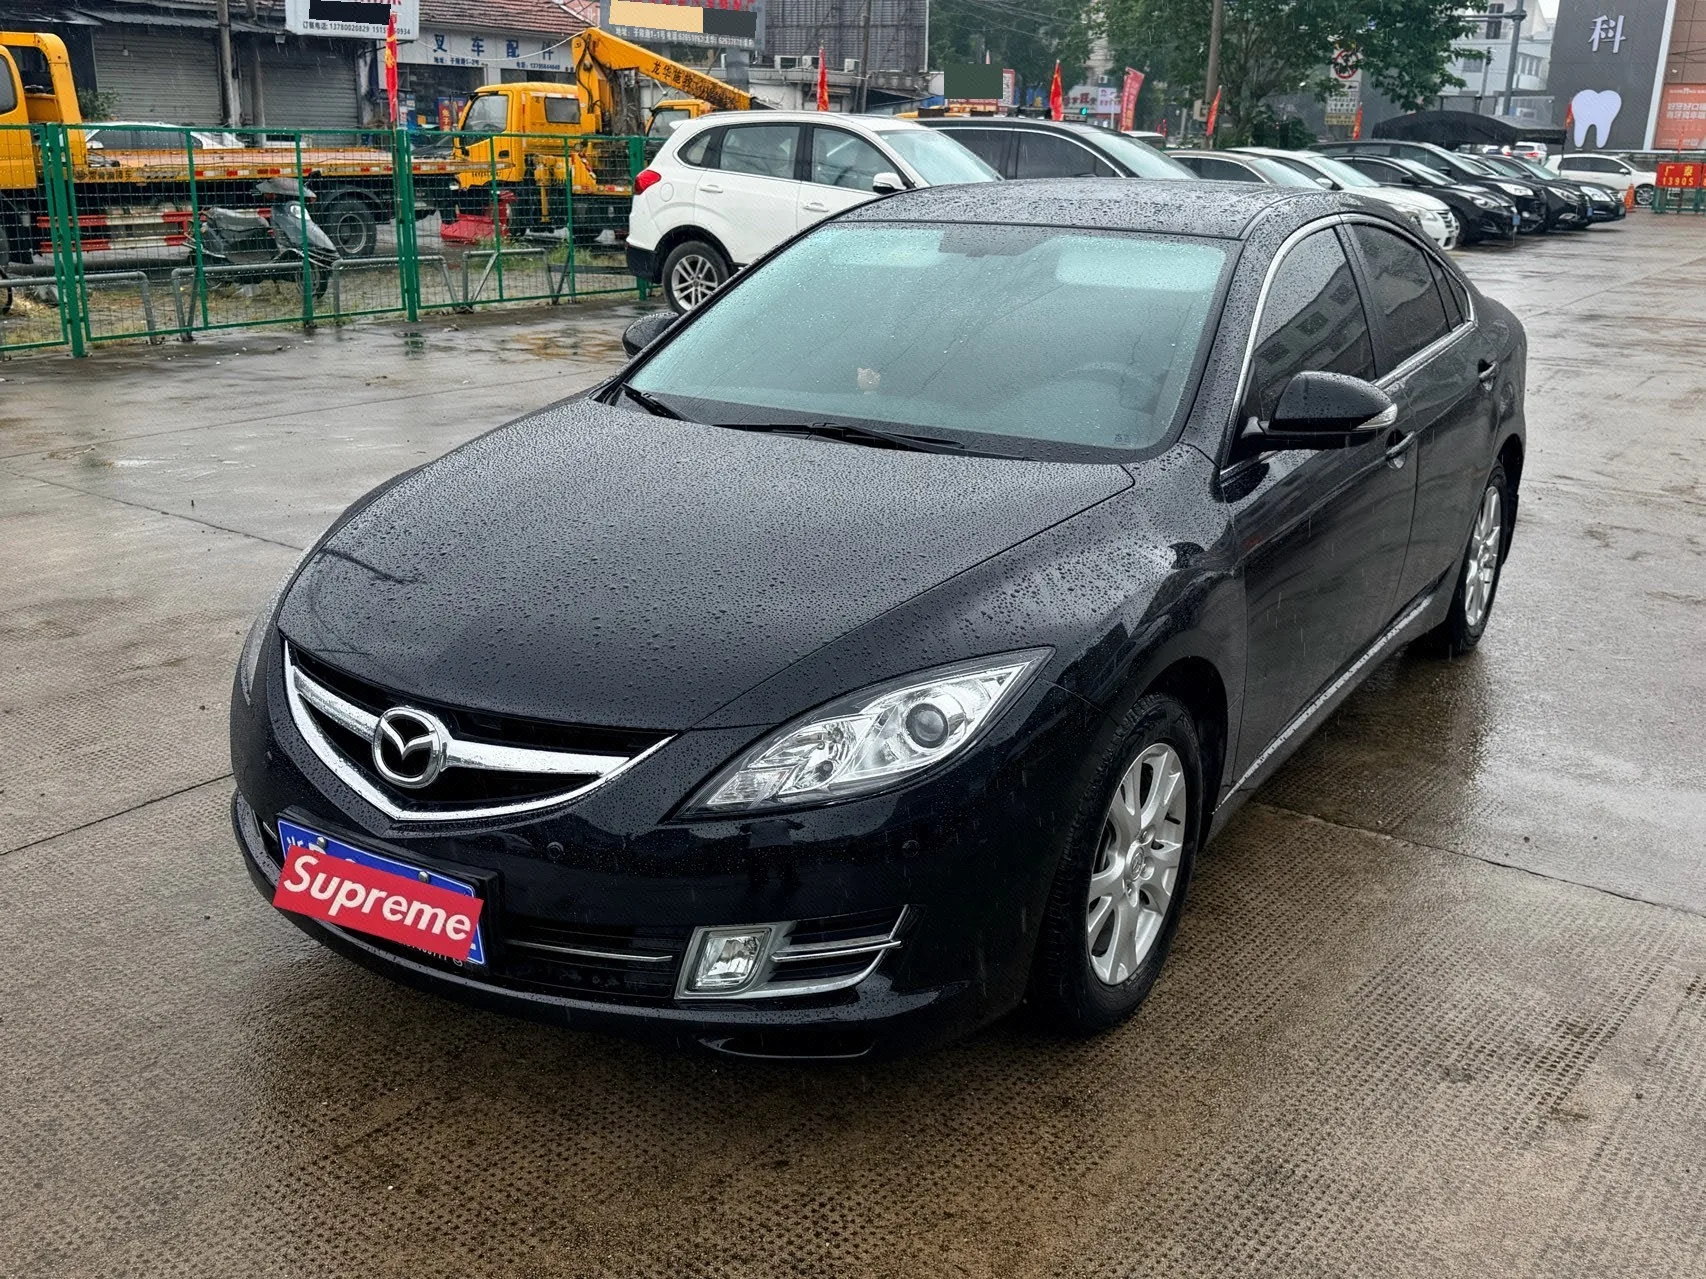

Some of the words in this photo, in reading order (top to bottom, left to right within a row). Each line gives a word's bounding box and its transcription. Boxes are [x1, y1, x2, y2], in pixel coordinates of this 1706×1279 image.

[433, 34, 554, 60] 叉车配件
[1588, 15, 1626, 53] 科
